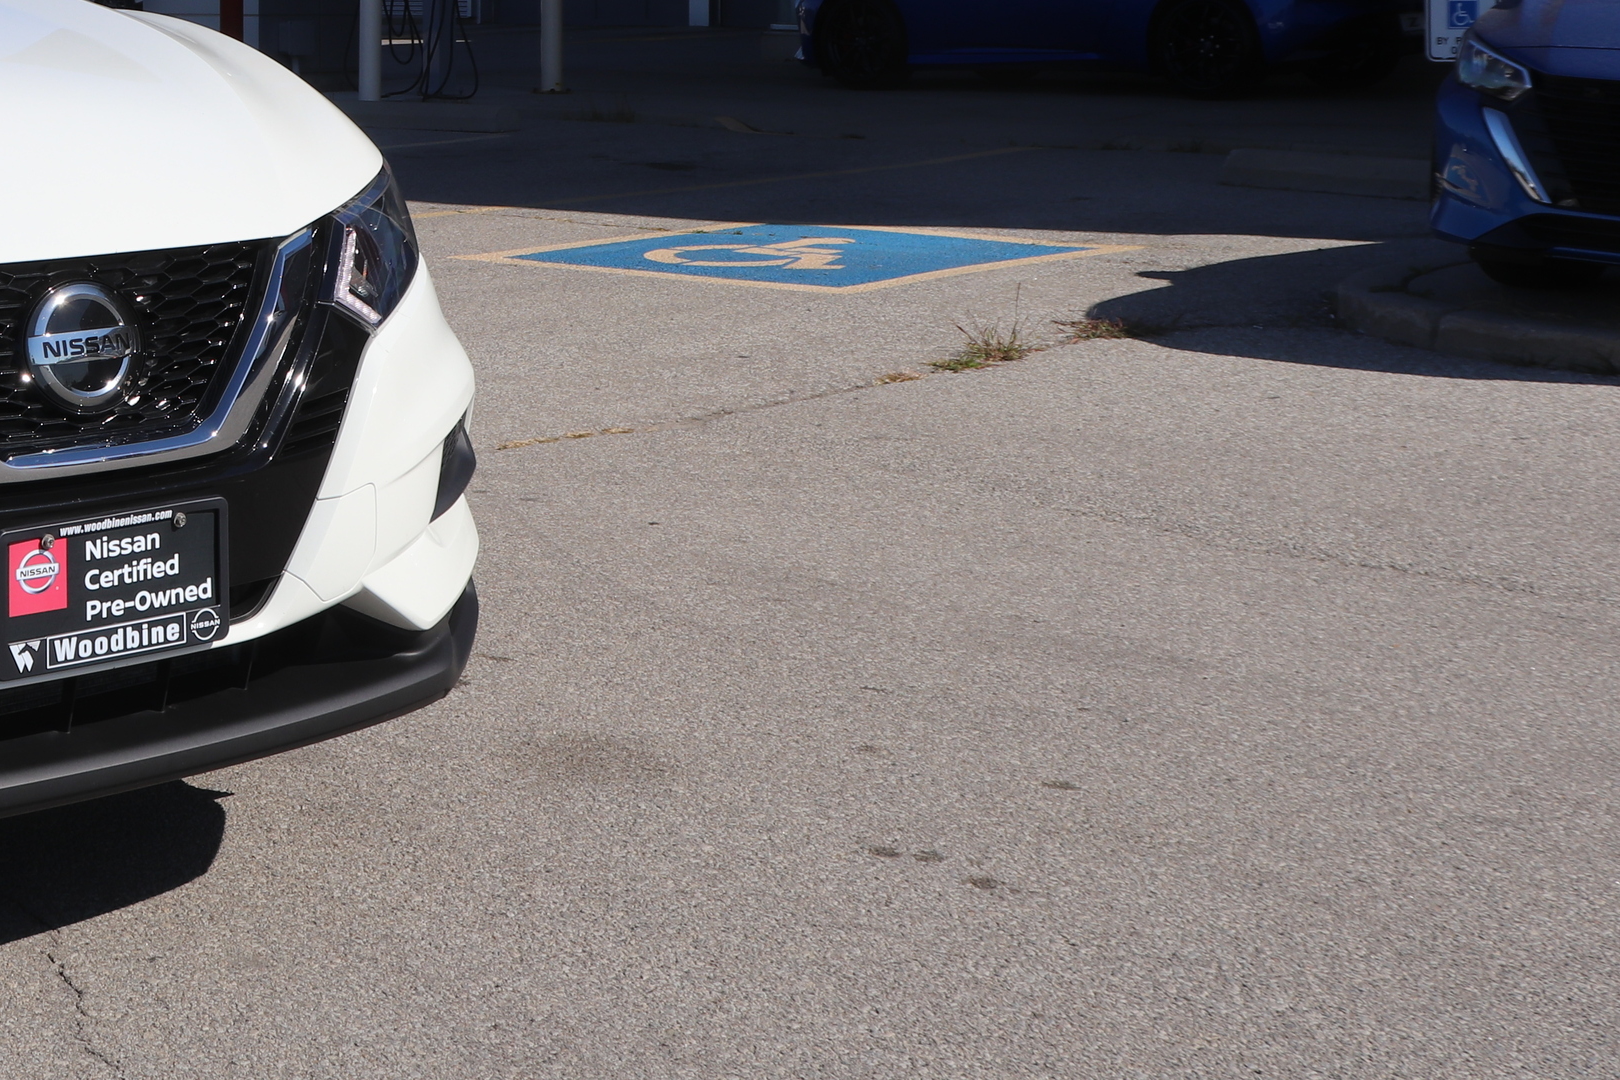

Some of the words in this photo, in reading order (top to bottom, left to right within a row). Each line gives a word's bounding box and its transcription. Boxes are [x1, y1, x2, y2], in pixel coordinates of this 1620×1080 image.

[42, 332, 130, 358] NISSAN
[59, 509, 173, 537] www.woodbinenissan.com
[85, 532, 161, 561] Nissan
[19, 566, 56, 578] NISSAN
[84, 553, 180, 591] Certified
[85, 577, 213, 622] Pre-Owned
[190, 618, 221, 631] NISSAN
[54, 621, 181, 662] Woodbine
